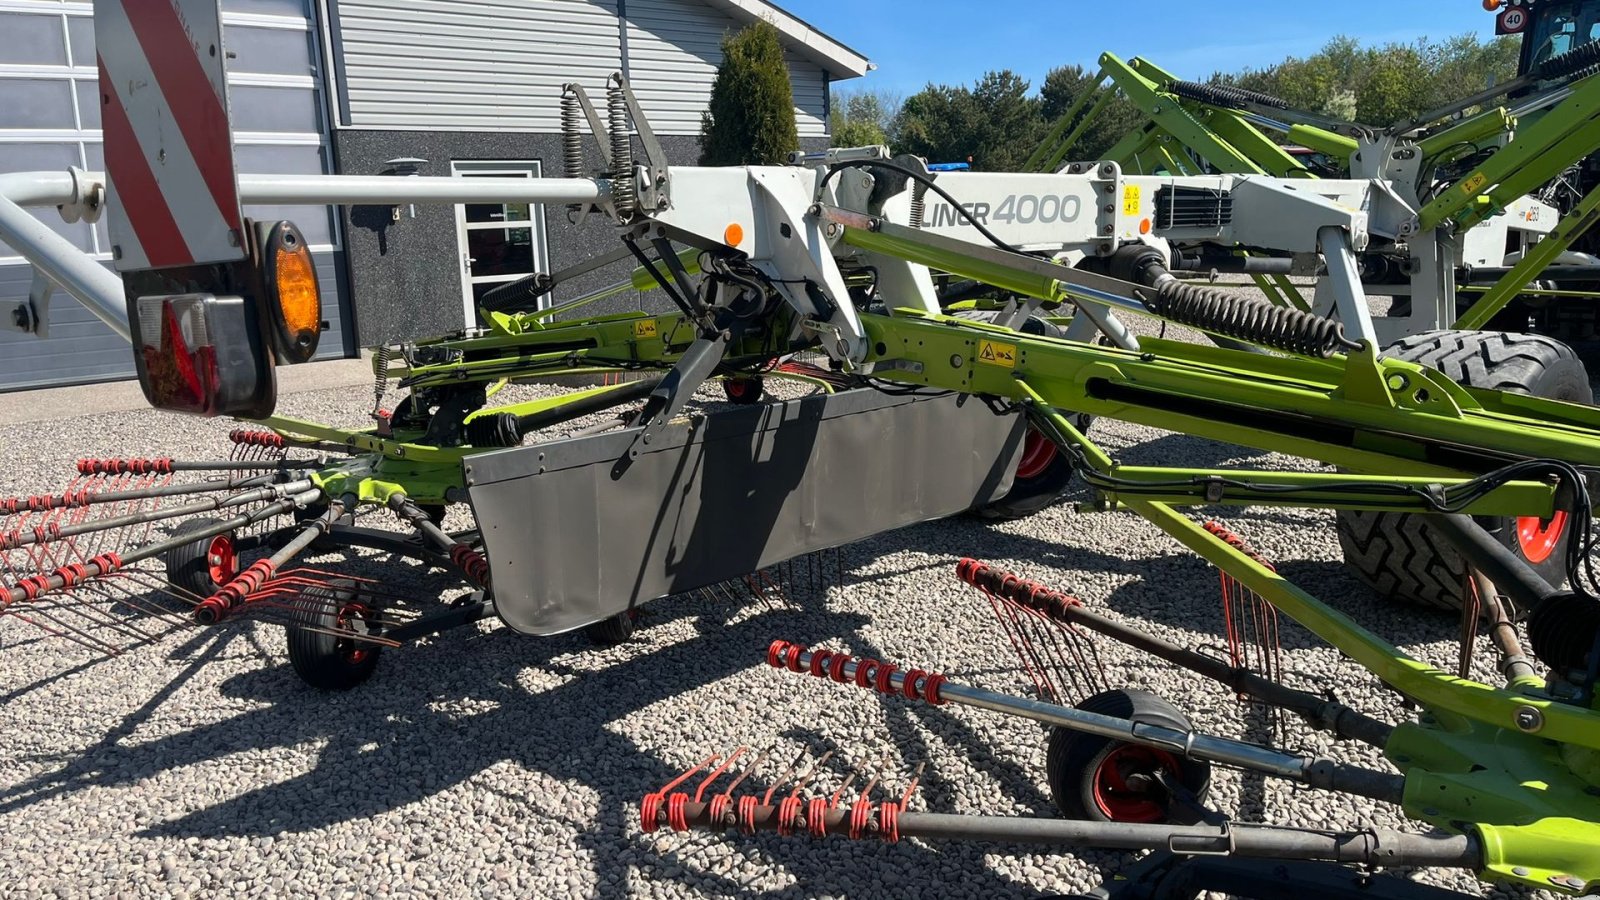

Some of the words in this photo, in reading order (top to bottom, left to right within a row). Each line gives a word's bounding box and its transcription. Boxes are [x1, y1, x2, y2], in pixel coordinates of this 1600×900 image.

[1507, 14, 1521, 25] 40
[920, 203, 991, 228] LINER
[992, 194, 1081, 224] 4000
